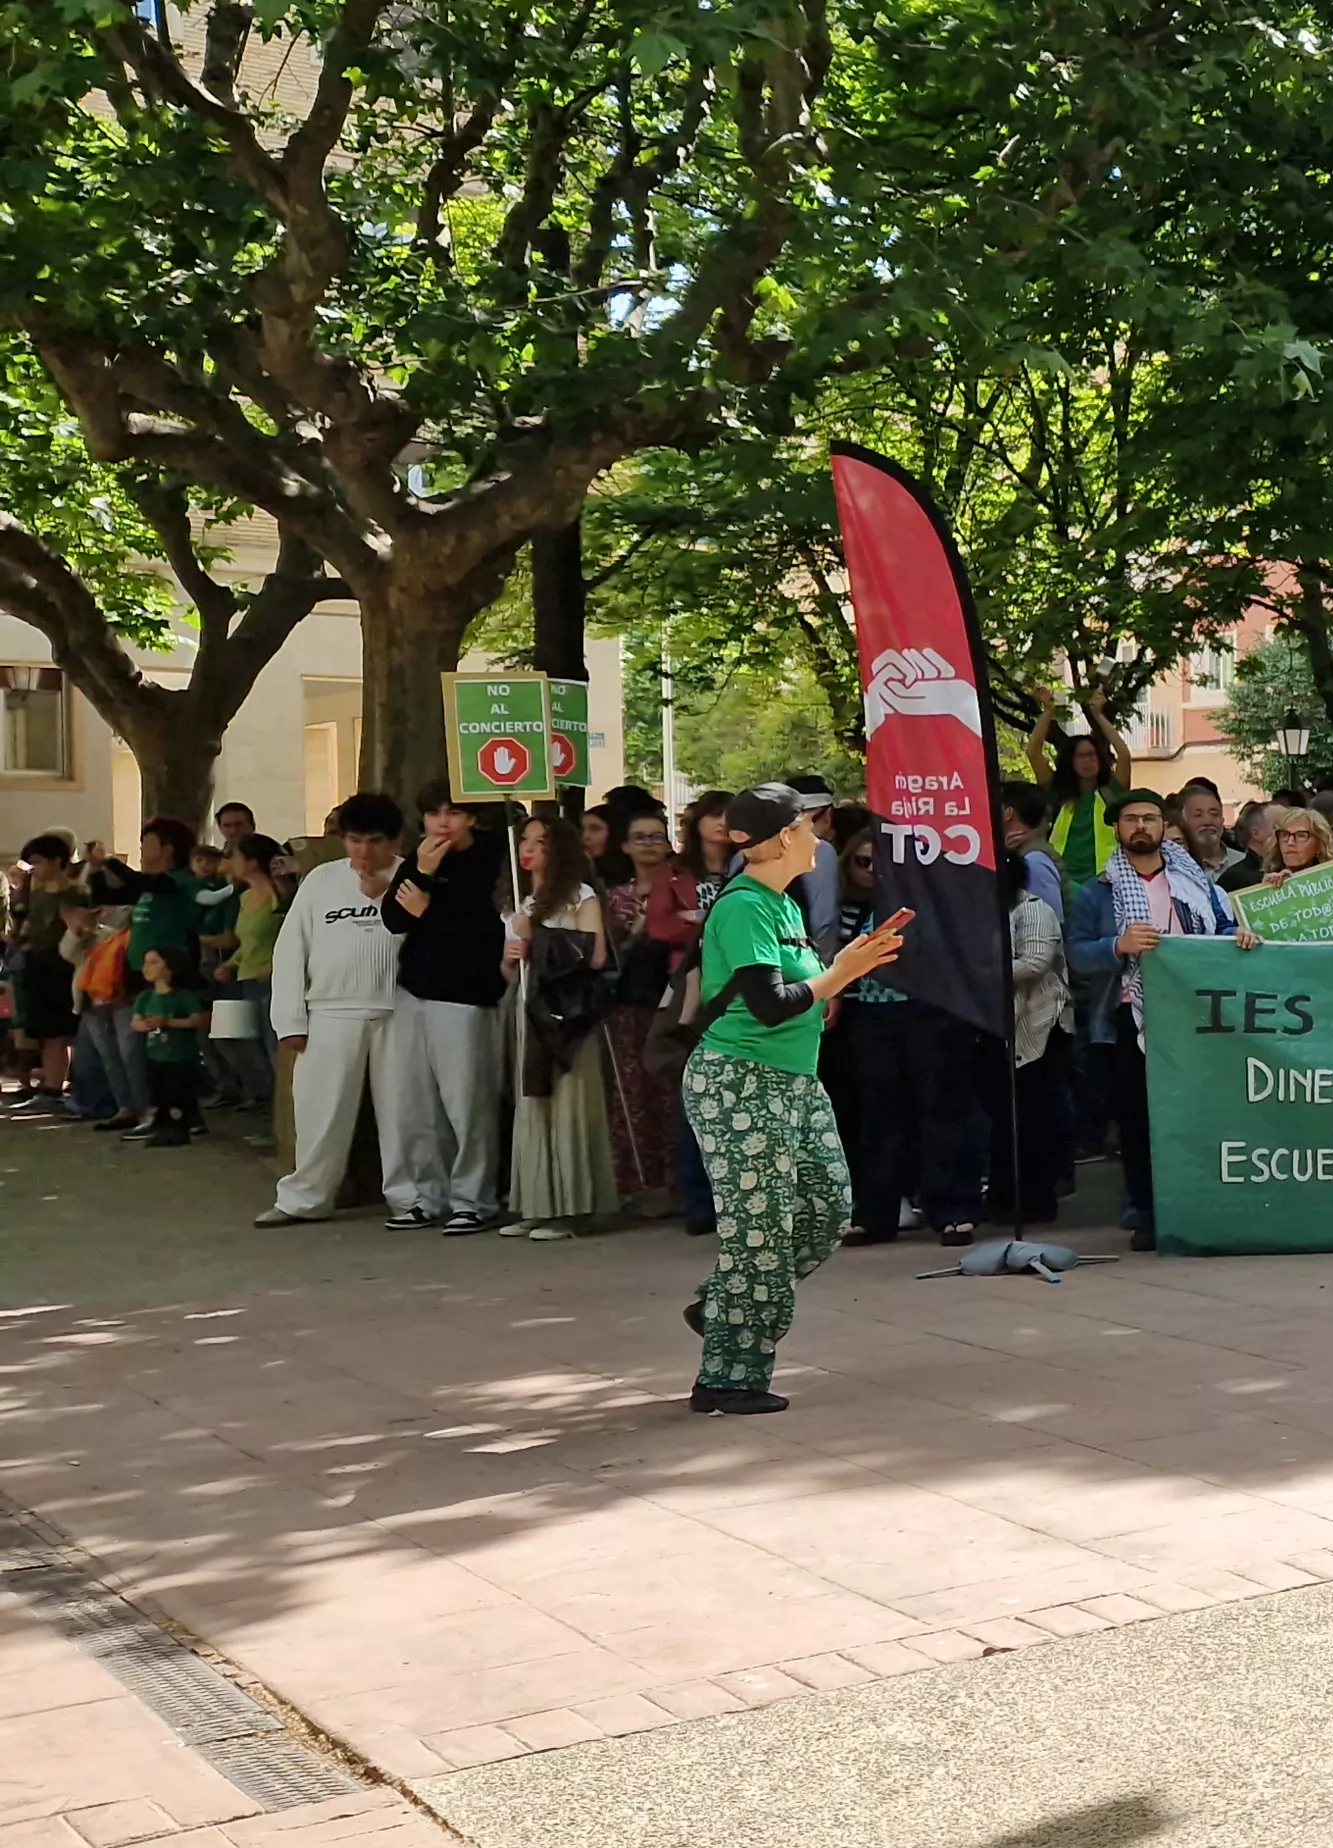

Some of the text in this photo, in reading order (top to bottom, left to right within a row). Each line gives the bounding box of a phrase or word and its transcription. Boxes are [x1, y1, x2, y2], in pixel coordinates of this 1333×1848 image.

[487, 685, 511, 696] NO
[490, 703, 510, 714] AL
[459, 721, 544, 733] CONCIERTO
[551, 719, 587, 732] CIERTO
[1251, 886, 1297, 912] ESCUELA
[1270, 919, 1288, 933] DE
[1195, 989, 1314, 1035] IES
